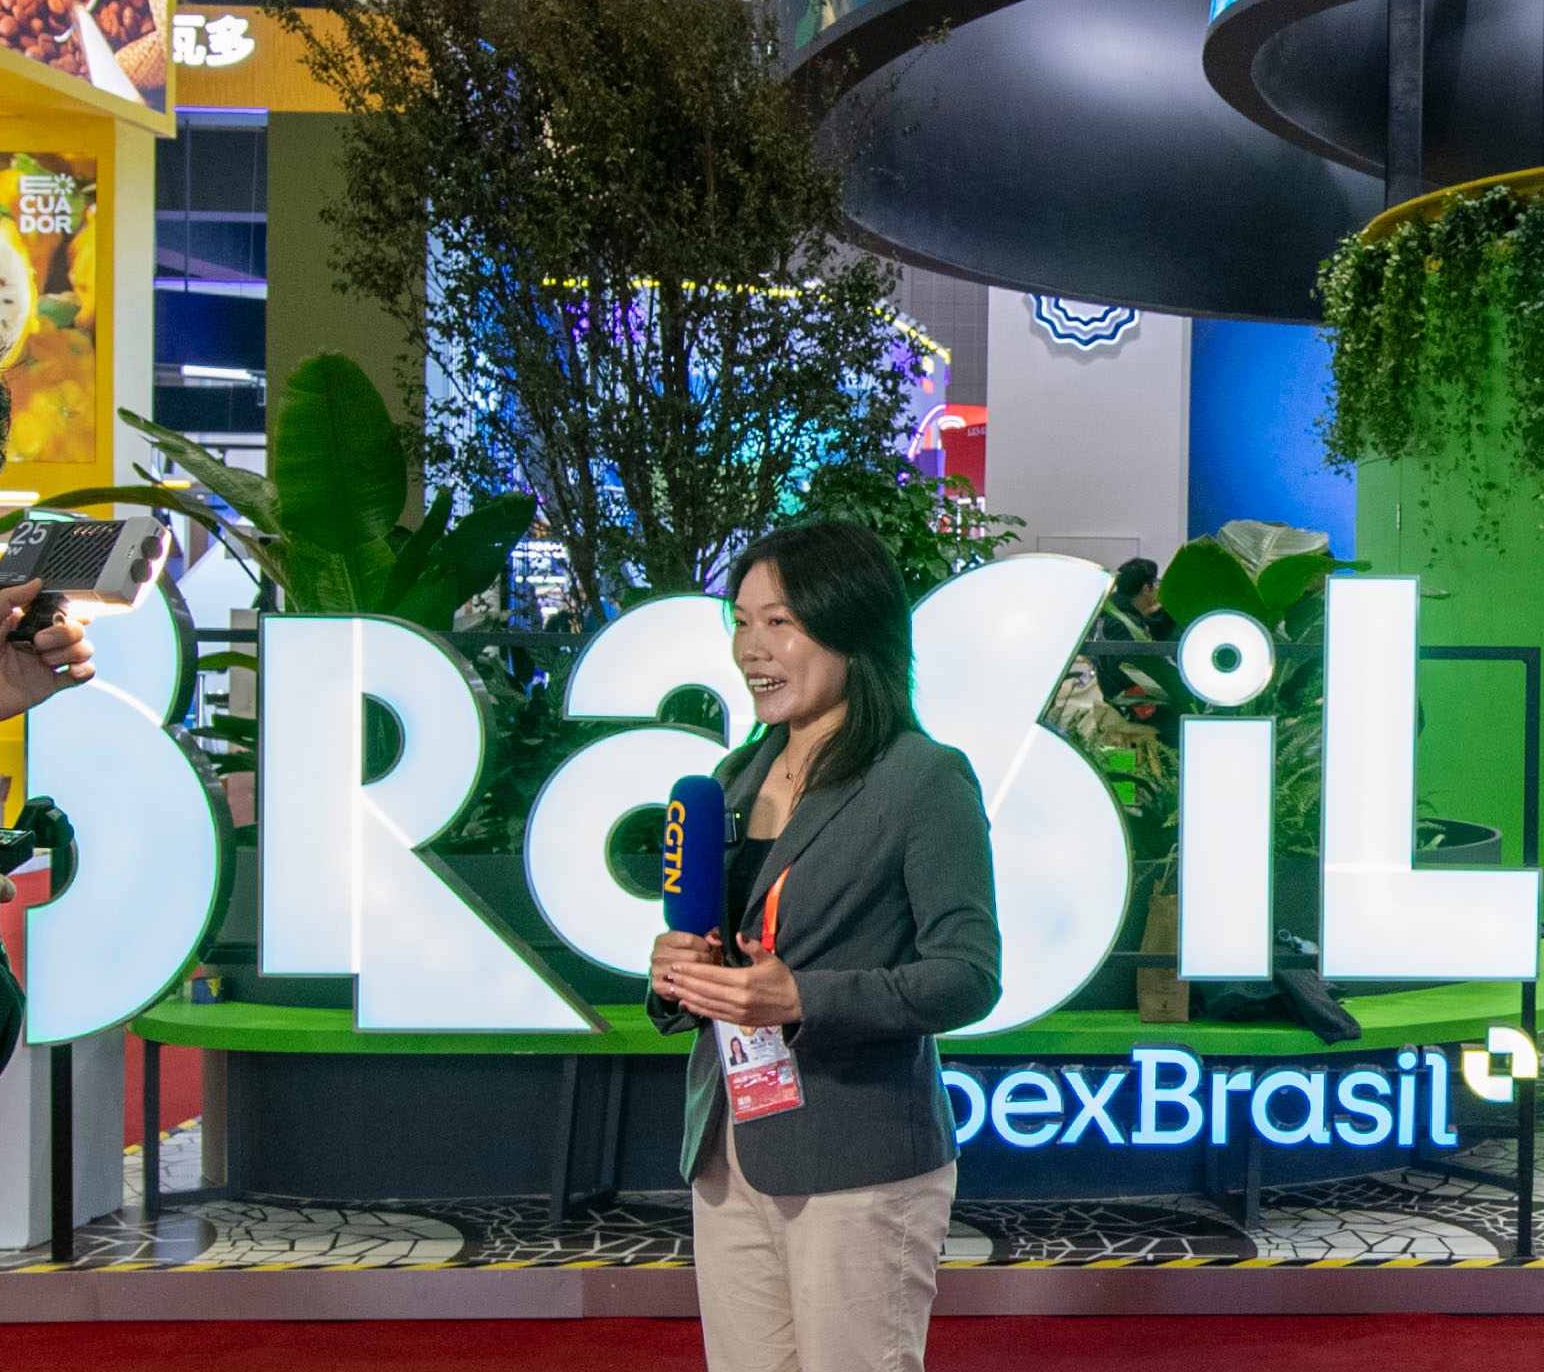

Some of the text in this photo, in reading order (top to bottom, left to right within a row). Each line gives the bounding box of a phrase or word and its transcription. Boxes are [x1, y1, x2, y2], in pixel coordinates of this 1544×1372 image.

[10, 520, 53, 545] 25
[664, 800, 686, 894] CGTN
[941, 1043, 1458, 1148] pexBrasil
